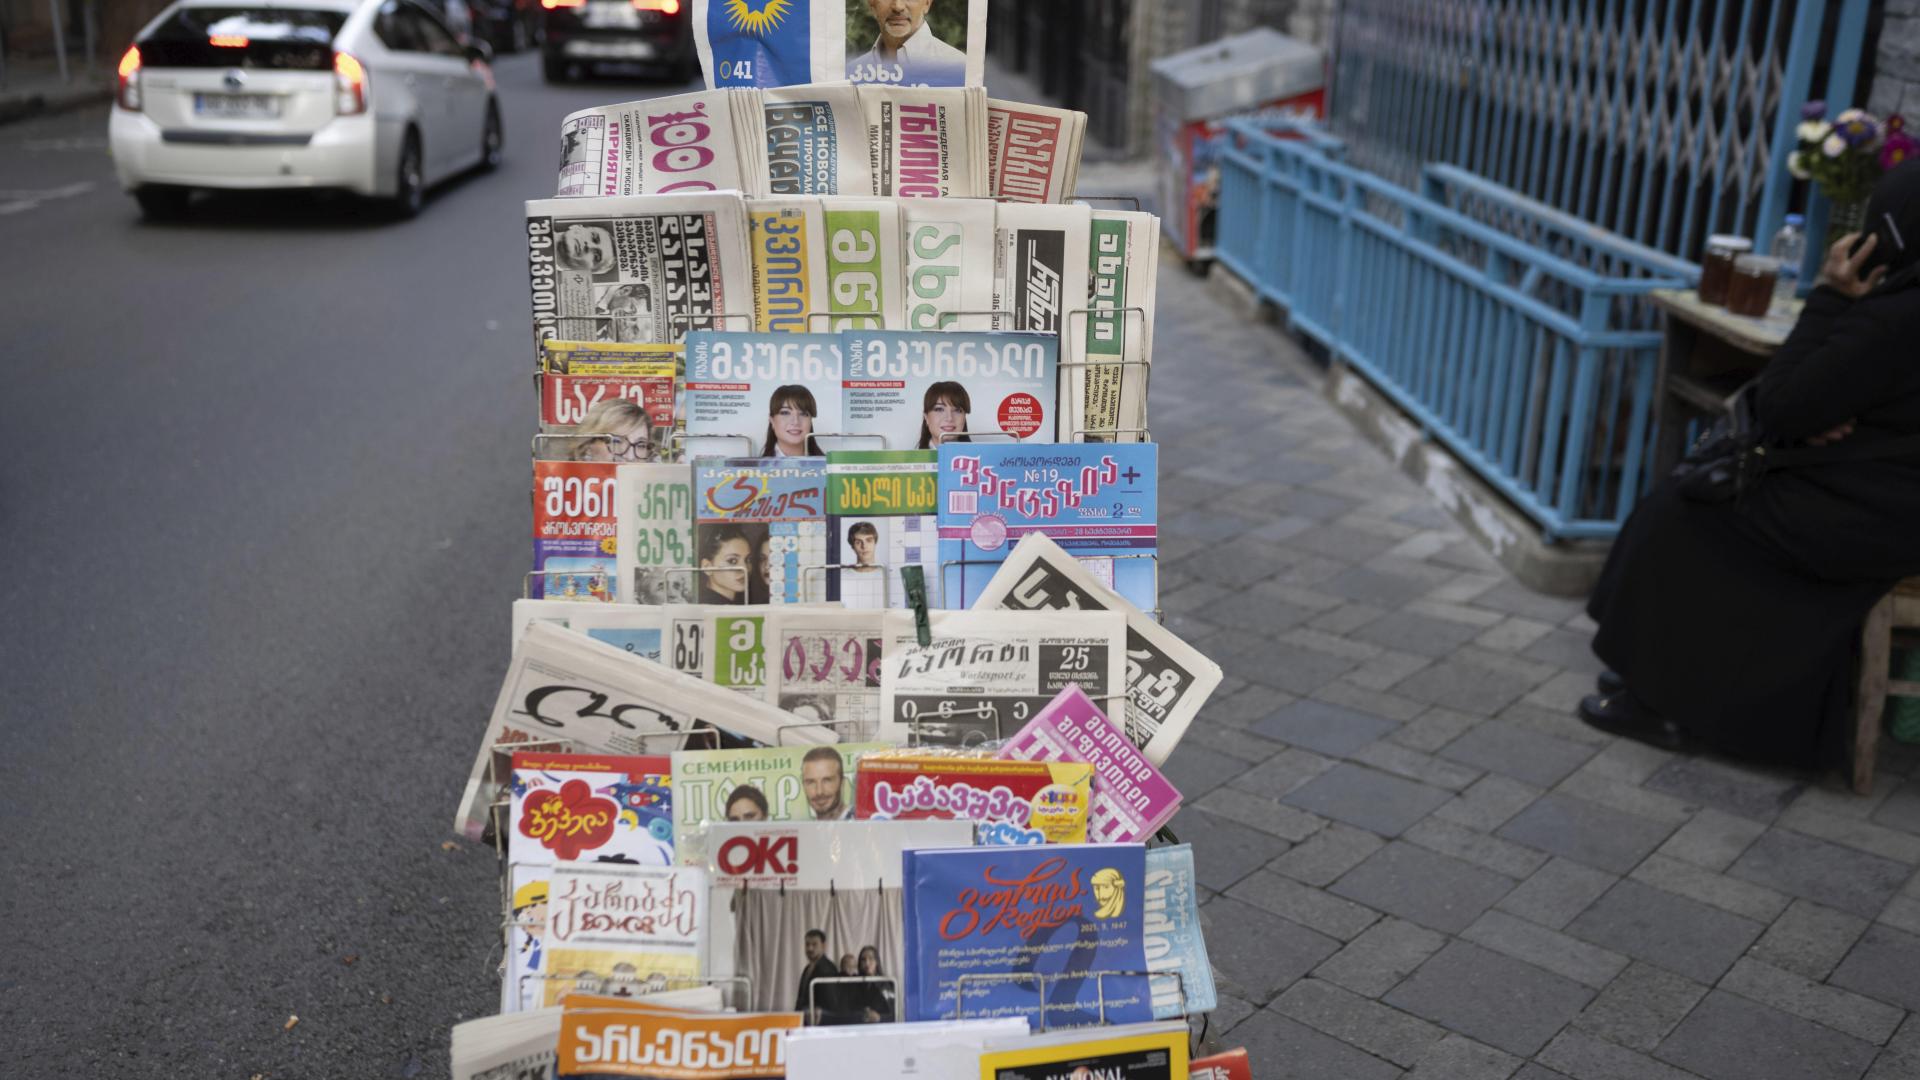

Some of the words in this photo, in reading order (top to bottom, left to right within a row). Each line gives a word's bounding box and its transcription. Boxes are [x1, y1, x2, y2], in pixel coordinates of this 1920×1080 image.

[733, 61, 753, 79] 41
[851, 63, 903, 82] კახა
[623, 114, 632, 162] СКАНДВОРДЫ
[814, 106, 829, 133] ВСЕ
[604, 122, 619, 196] ПРИЯТН
[899, 103, 940, 198] ТБИЛИС
[938, 105, 950, 181] ЕЖЕНЕДЕЛЬНАЯ
[803, 139, 813, 196] ПРОГРАМ
[683, 216, 713, 332] ასავა
[1094, 234, 1122, 341] ახალი
[867, 339, 1044, 379] მკურნალი
[703, 468, 827, 479] კროსვორ
[1000, 457, 1081, 468] კროსვორდები
[543, 476, 617, 518] შენი
[840, 477, 901, 509] ახალი
[906, 477, 936, 509] სკა
[952, 456, 1118, 518] ფანტაზია
[1078, 506, 1108, 518] ფასი
[1112, 503, 1124, 519] 2
[636, 527, 693, 566] გაზ
[675, 624, 704, 671] ბე
[1060, 646, 1090, 671] 25
[1126, 686, 1167, 720] ნფო
[682, 757, 792, 775] СЕМЕЙНЫЙ
[1055, 713, 1153, 811] შიფრვორდი
[1085, 714, 1152, 782] მხოლოდ
[874, 775, 1031, 825] საბავშვო
[528, 807, 610, 842] პეპელა
[718, 836, 798, 876] OK!
[552, 873, 698, 941] კარიბჭე
[574, 1024, 786, 1070] არსენალი
